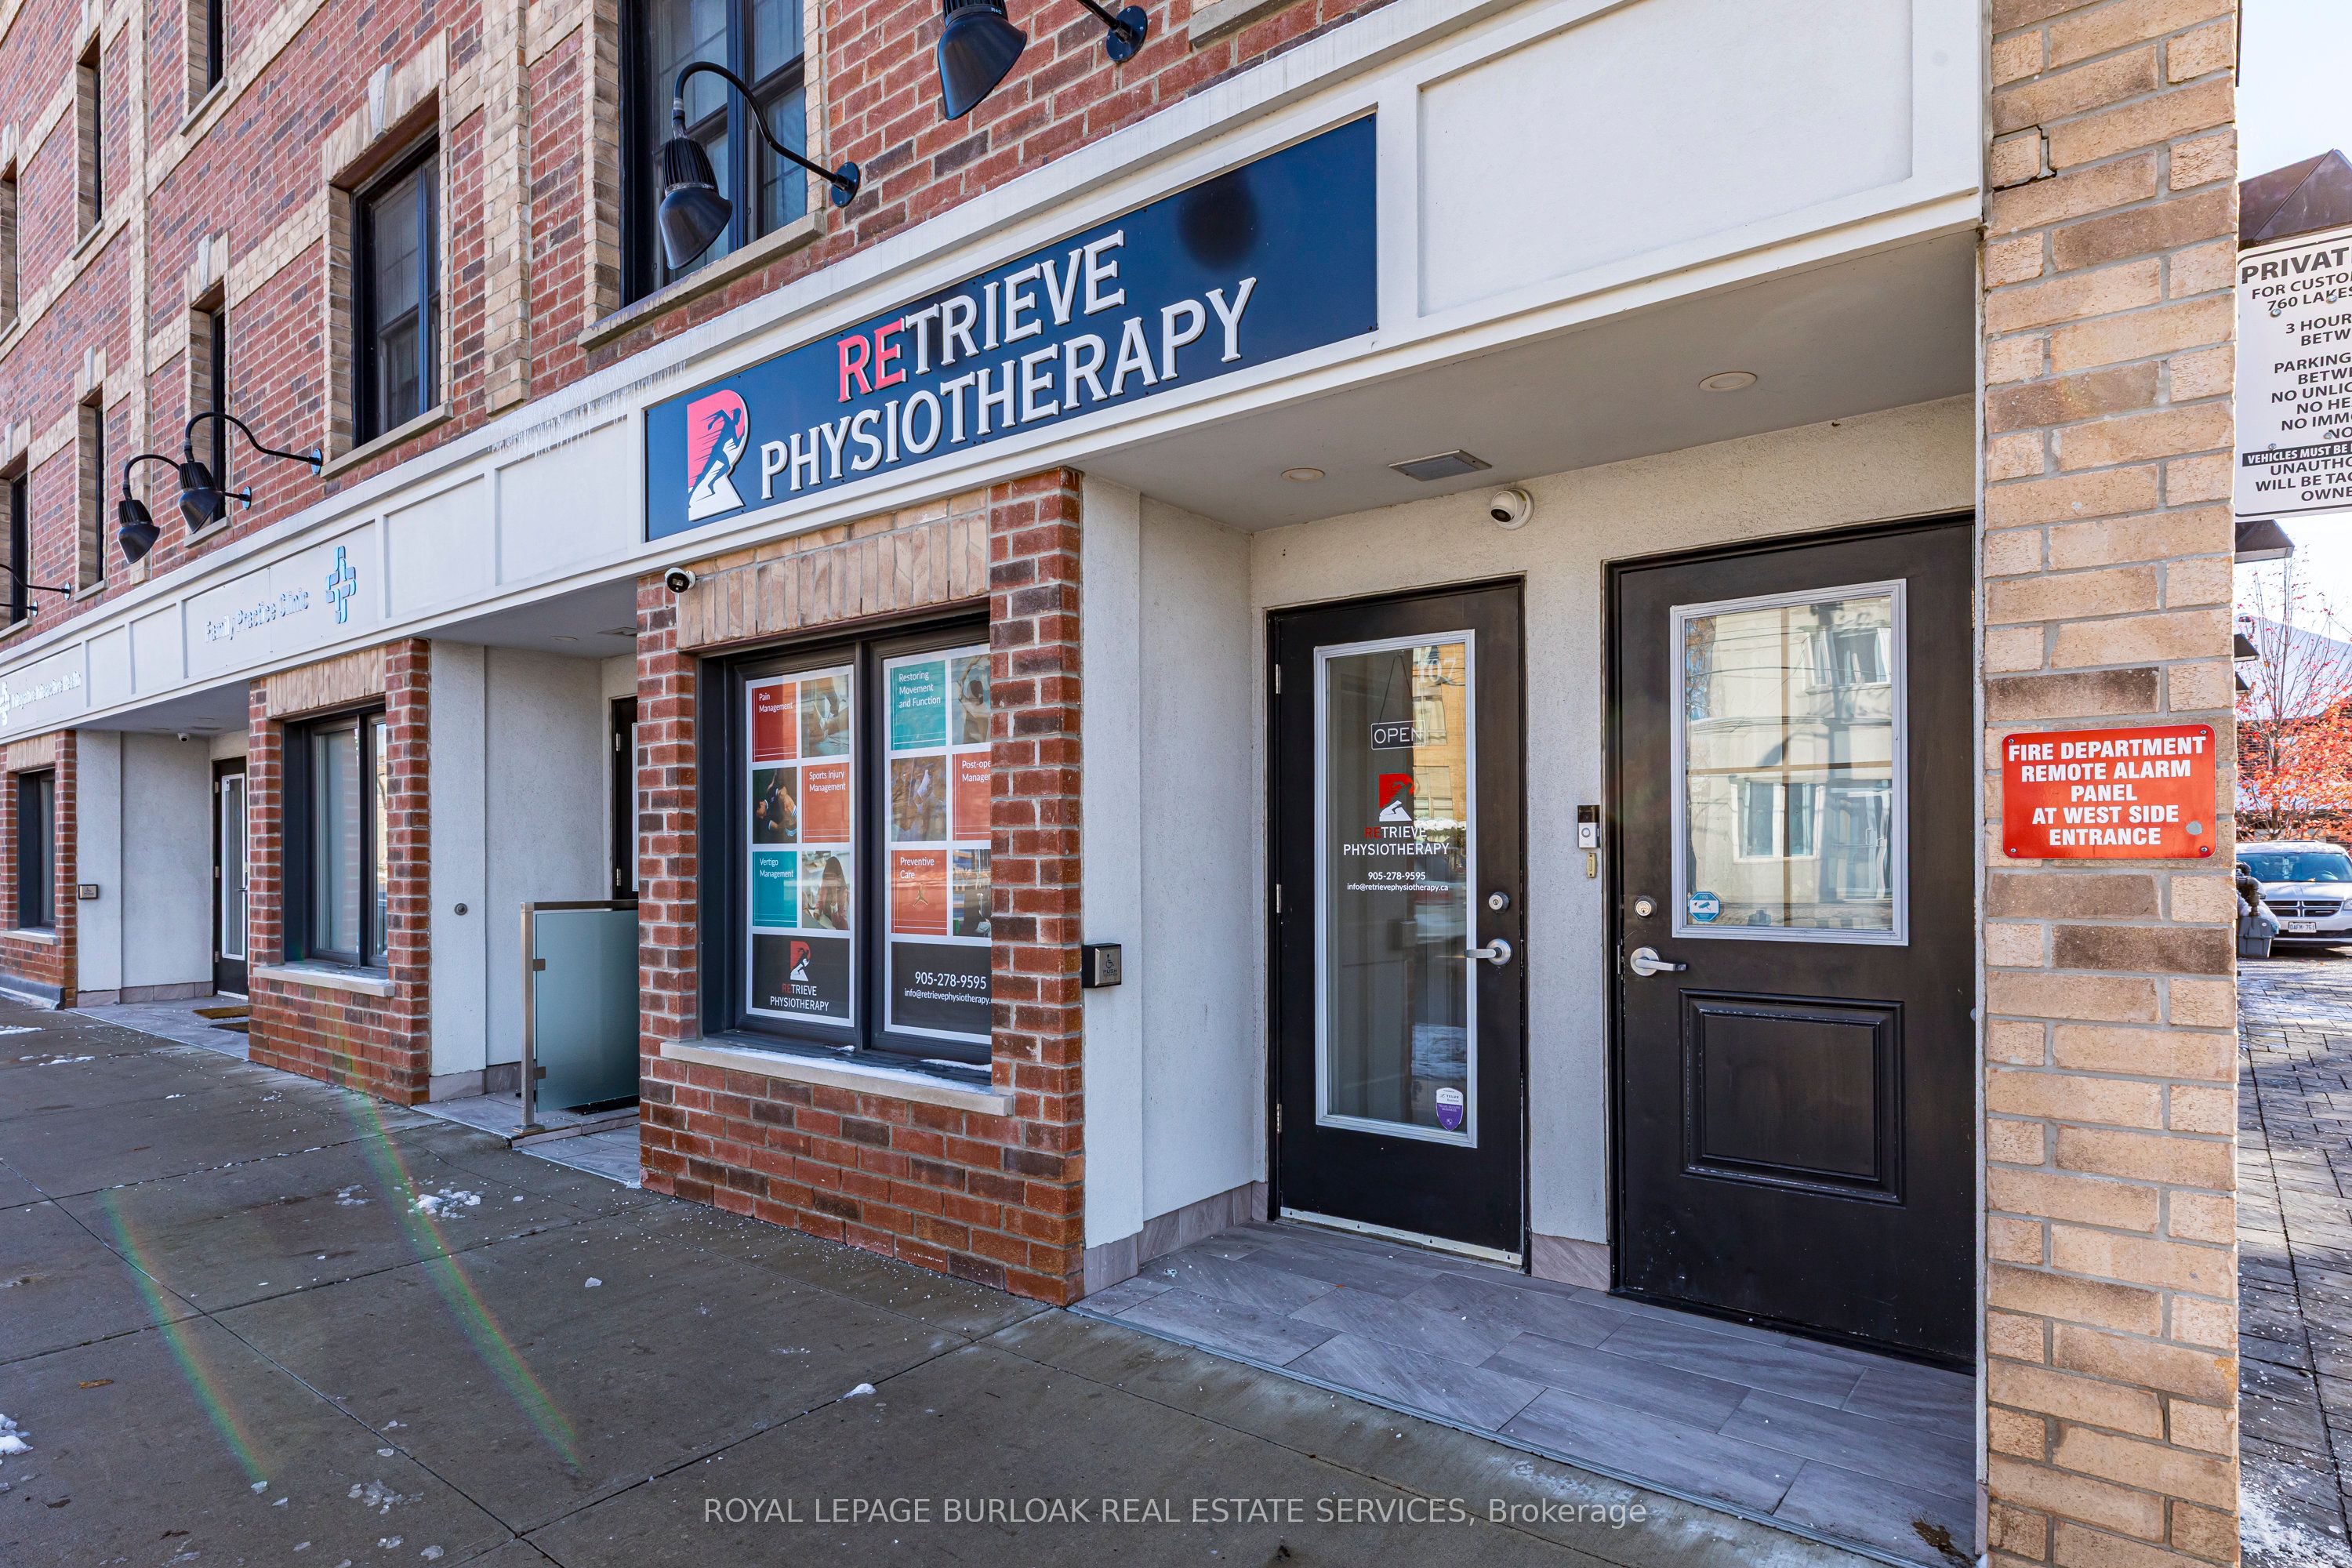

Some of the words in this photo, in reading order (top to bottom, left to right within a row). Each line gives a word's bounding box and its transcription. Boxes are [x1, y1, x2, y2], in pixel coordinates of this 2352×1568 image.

[2242, 246, 2352, 284] PRIVAT
[2252, 285, 2285, 299] FOR
[2290, 270, 2352, 292] CUSTO
[2267, 297, 2298, 312] 760
[837, 229, 1126, 404] RETRIEVE
[2285, 323, 2295, 334] 3
[2301, 328, 2351, 346] BETW
[2274, 352, 2351, 374] PARKING
[2298, 367, 2352, 385] BETW
[760, 277, 1257, 499] PHYSIOTHERAPY
[2271, 390, 2297, 403] NO
[2296, 401, 2322, 415] NO
[2328, 397, 2352, 411] HE
[2281, 418, 2307, 431] NO
[2313, 412, 2352, 427] IMM
[2328, 426, 2352, 439] NO
[2248, 450, 2297, 464] VEHICLES
[2299, 445, 2332, 459] MUST
[2333, 444, 2347, 455] BE
[2256, 477, 2296, 492] WILL
[2301, 475, 2321, 487] BE
[205, 615, 234, 643] Family
[236, 601, 276, 632] Practice
[278, 588, 309, 617] Clinic
[898, 671, 929, 682] Restoring
[899, 684, 934, 695] Movement
[759, 693, 771, 702] Pain
[898, 699, 911, 709] and
[913, 695, 941, 707] Function
[759, 702, 793, 713] Management
[1374, 727, 1423, 744] OPEN
[2009, 742, 2053, 762] FIRE
[2060, 736, 2206, 760] DEPARTMENT
[809, 771, 827, 781] Sports
[828, 769, 845, 780] Injury
[2021, 762, 2107, 782] REMOTE
[2114, 760, 2190, 779] ALARM
[809, 782, 846, 793] Management
[2071, 784, 2137, 802] PANEL
[2032, 808, 2057, 825] AT
[2063, 806, 2122, 824] WEST
[2129, 804, 2179, 823] SIDE
[1364, 826, 1427, 838] RETRIEVE
[2049, 827, 2161, 846] ENTRANCE
[1343, 842, 1450, 856] PHYSIOTHERAPY
[759, 858, 779, 869] Vertigo
[900, 856, 935, 866] Preventive
[759, 869, 793, 880] Management
[900, 869, 916, 880] Care
[1367, 871, 1426, 881] 905-278-9595
[1347, 883, 1449, 892] info@retrievephysiotherapy.ca
[915, 971, 986, 989] 905-278-9595
[782, 983, 817, 996] RETRIEVE
[770, 996, 829, 1011] PHYSIOTHERAPY
